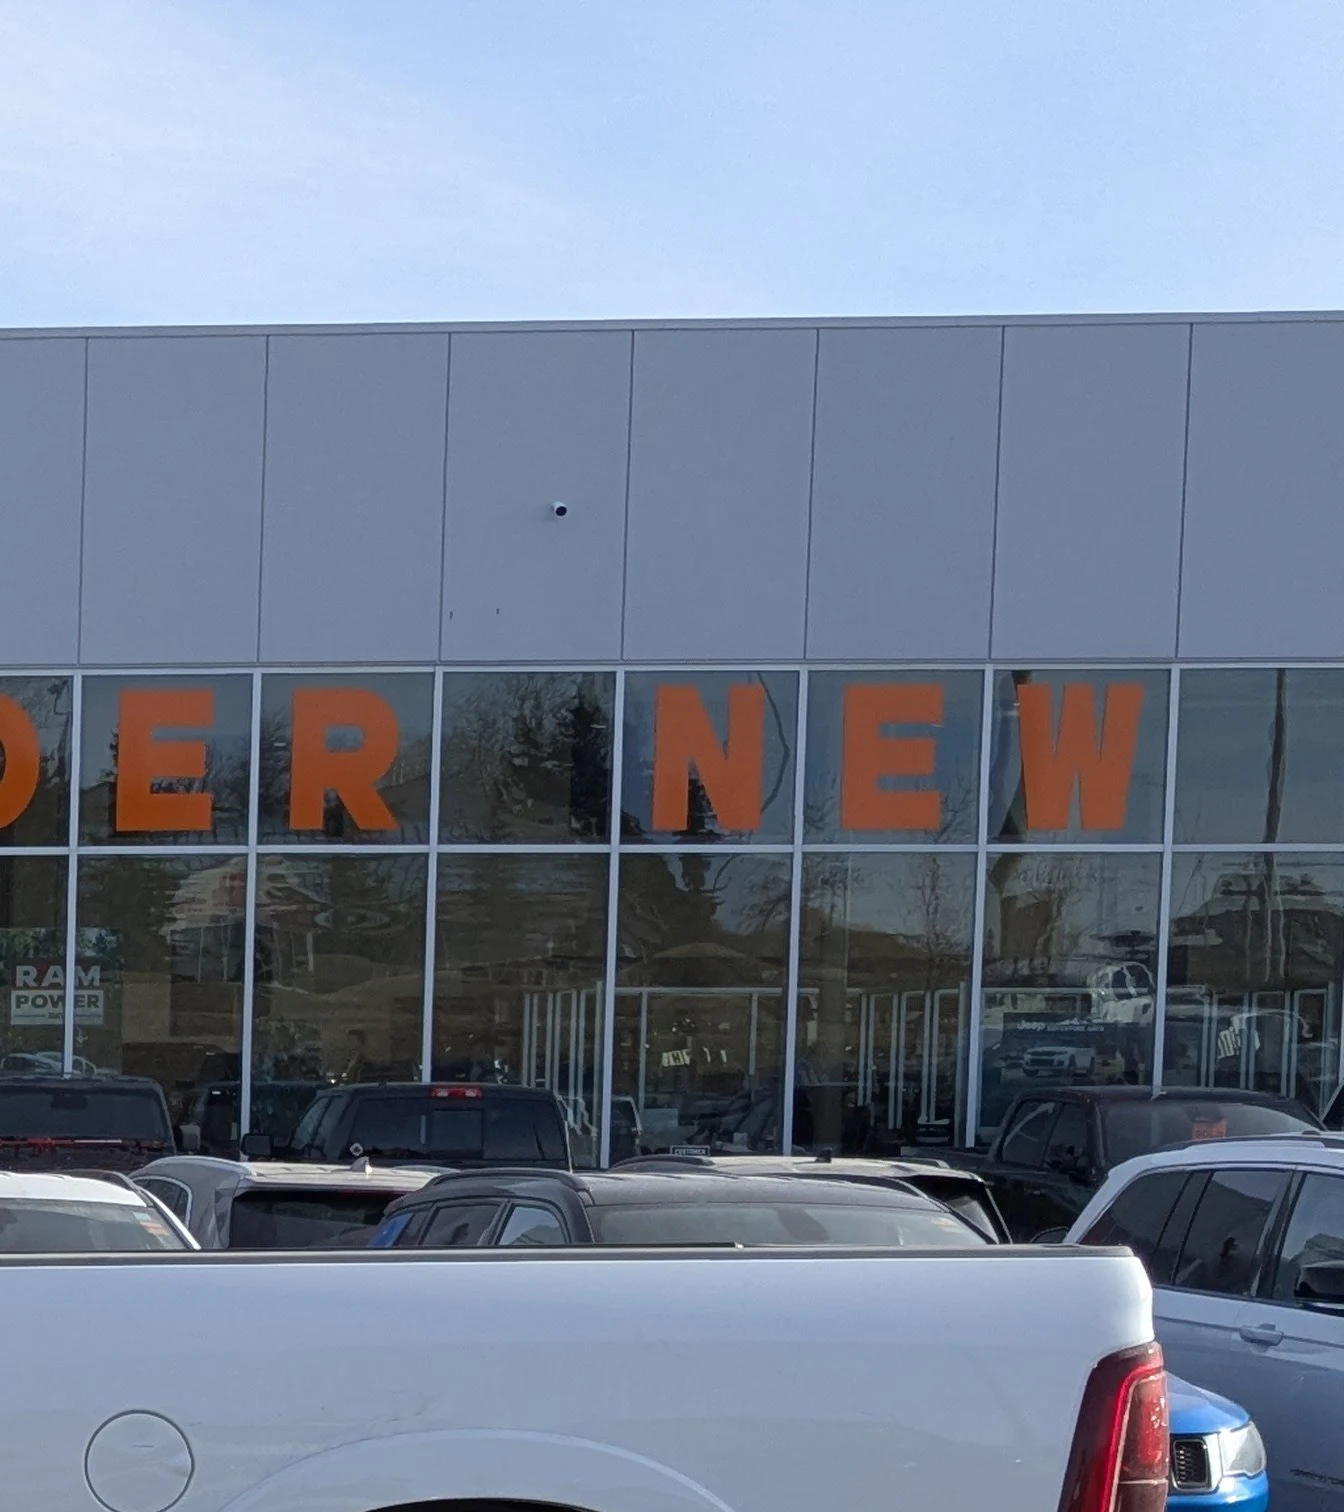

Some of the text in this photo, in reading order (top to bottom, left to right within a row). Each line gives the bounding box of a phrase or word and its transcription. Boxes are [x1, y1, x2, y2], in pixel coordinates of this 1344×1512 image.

[653, 683, 1145, 831] NEW
[15, 965, 101, 987] RAM
[15, 994, 100, 1009] POWER
